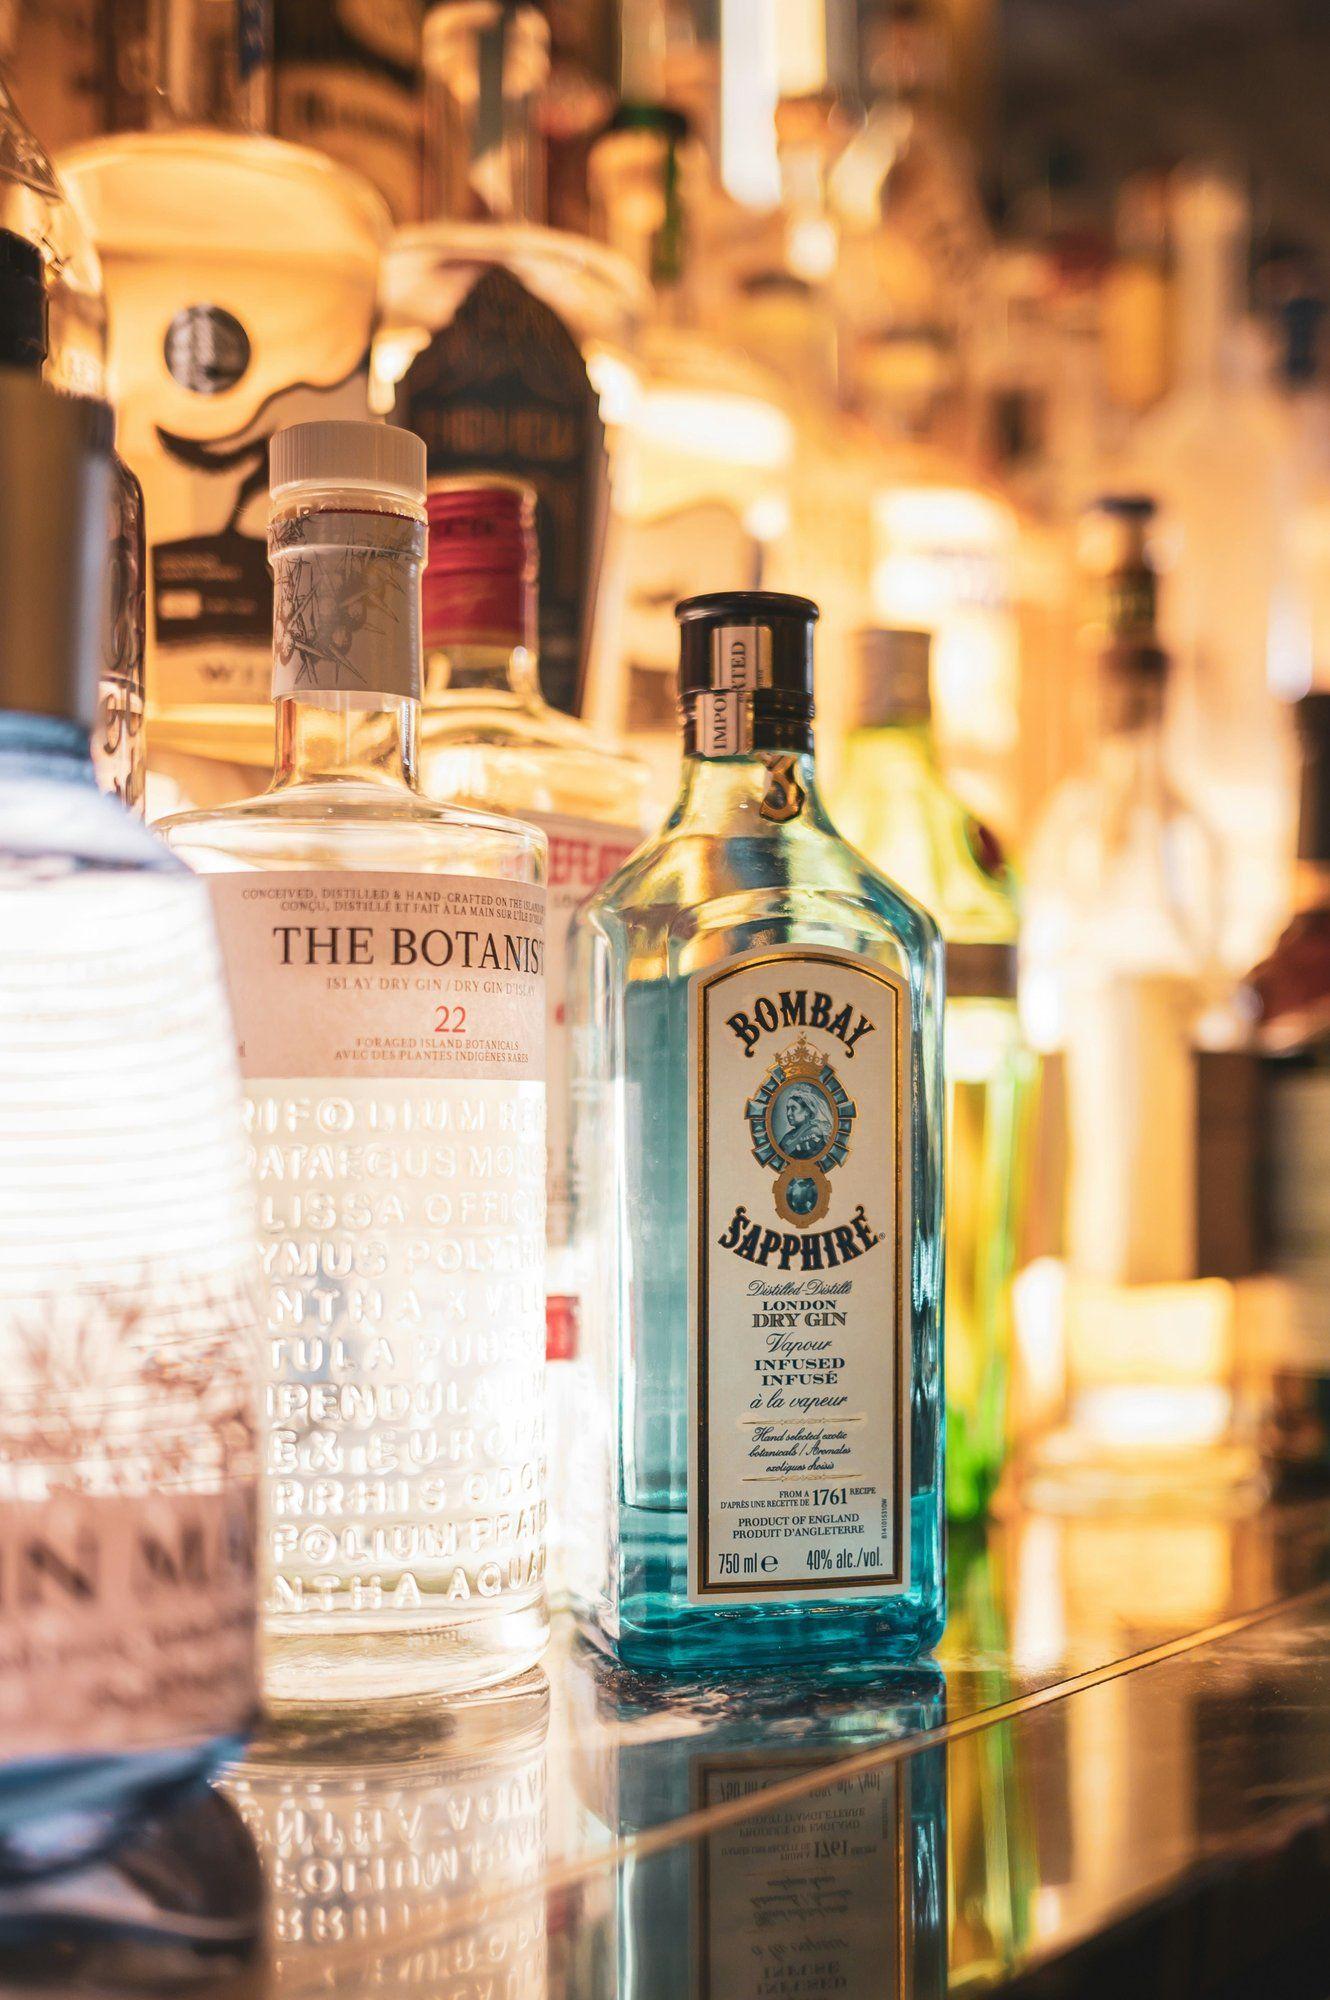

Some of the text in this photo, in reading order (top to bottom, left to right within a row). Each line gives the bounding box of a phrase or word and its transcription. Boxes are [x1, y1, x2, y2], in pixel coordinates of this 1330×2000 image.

[323, 888, 389, 900] DISTILLED
[496, 897, 507, 907] ON
[509, 898, 522, 910] THE
[414, 903, 438, 914] FAIT
[454, 904, 467, 916] LA
[470, 906, 494, 917] MAIN
[497, 908, 512, 920] SUR
[273, 926, 374, 965] THE
[327, 977, 371, 990] ISLAY
[379, 977, 409, 990] DRY
[415, 978, 441, 991] GIN
[455, 979, 484, 992] DRY
[484, 981, 503, 994] GIN
[434, 1005, 466, 1033] 22
[726, 990, 876, 1058] BOMBAY
[356, 1038, 519, 1051] FORAGED ISLAND BOTANICALS
[400, 1050, 451, 1062] PLANTES
[508, 1053, 529, 1063] RARES
[717, 1205, 878, 1271] SAPPHIRE
[761, 1300, 838, 1311] LONDON
[752, 1312, 848, 1328] DRY GIN
[766, 1332, 832, 1357] Vapour
[754, 1358, 845, 1371] INFUSED
[761, 1371, 838, 1386] INFUSÉ
[750, 1388, 848, 1414] à la vapeur
[752, 1427, 847, 1442] Hand selected exotic
[748, 1443, 799, 1457] botanicals
[766, 1461, 806, 1474] exotiques
[751, 1500, 766, 1509] UNE
[767, 1500, 799, 1508] RECETTE
[800, 1499, 810, 1507] DE
[780, 1487, 876, 1506] FROM A 1761 RECIPE
[738, 1513, 859, 1527] PRODUCT OF ENGLAND
[733, 1525, 865, 1539] PRODUIT D'ANGLETERRE
[719, 1553, 739, 1574] 750
[744, 1552, 758, 1573] ml
[806, 1549, 833, 1570] 40%
[836, 1547, 883, 1569] alc./vol.
